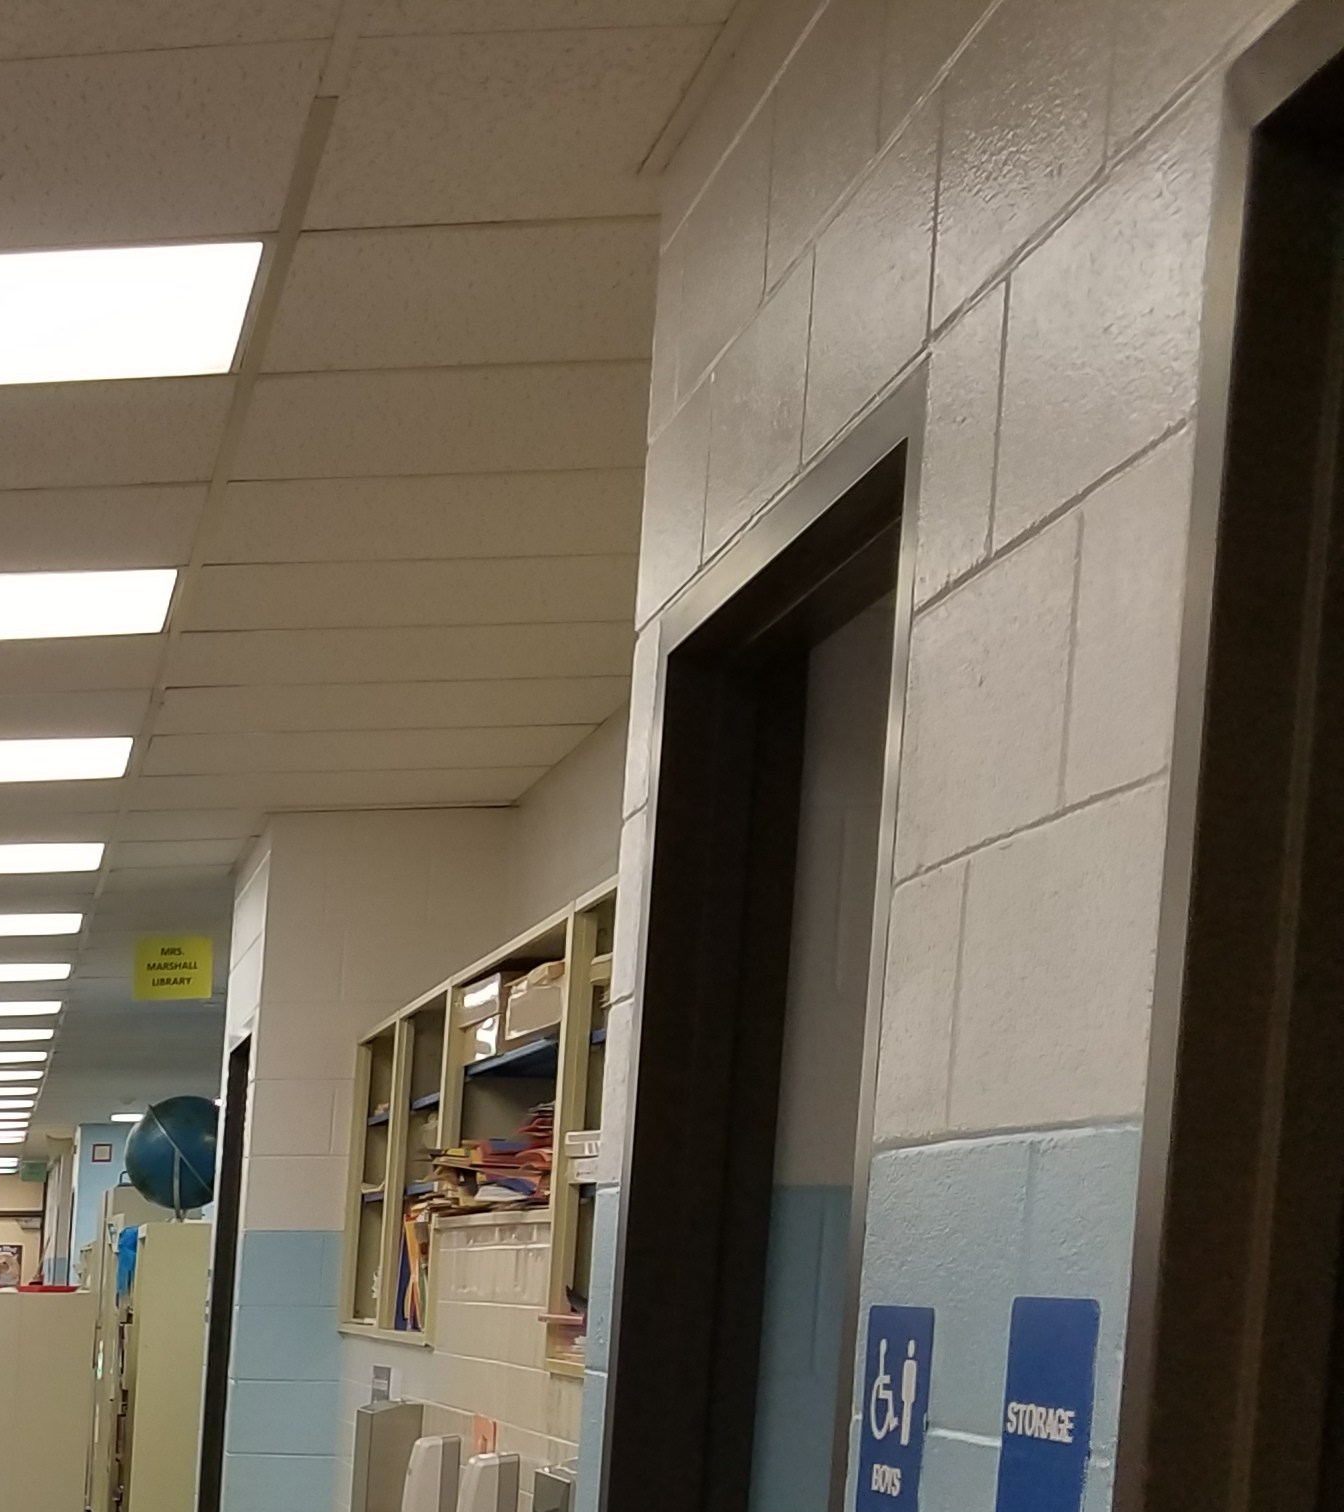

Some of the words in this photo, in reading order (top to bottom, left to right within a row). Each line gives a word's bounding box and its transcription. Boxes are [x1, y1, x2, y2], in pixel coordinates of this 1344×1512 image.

[152, 977, 192, 987] LIBRARY
[1006, 1402, 1075, 1443] STORAGE
[870, 1463, 901, 1497] BOYS
